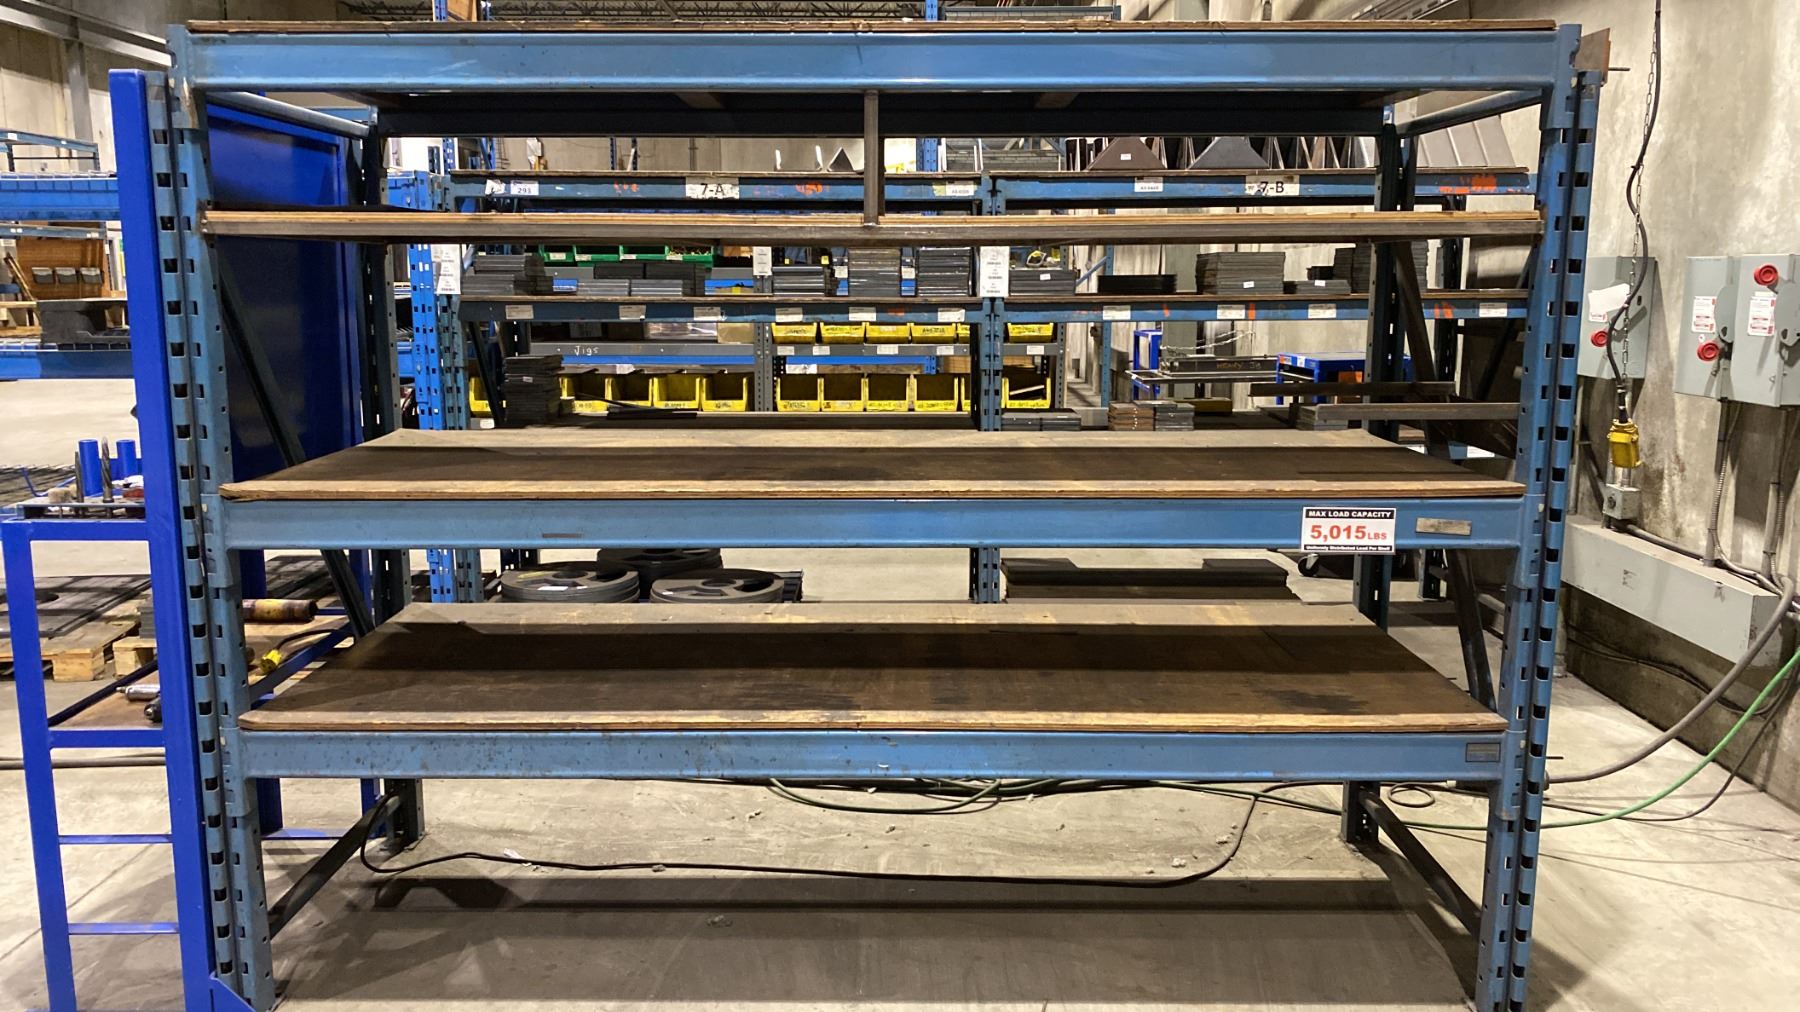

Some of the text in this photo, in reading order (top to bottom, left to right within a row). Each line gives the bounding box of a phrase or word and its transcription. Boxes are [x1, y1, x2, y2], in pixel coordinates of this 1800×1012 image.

[700, 182, 725, 196] 7-A
[1260, 181, 1285, 193] 7-B
[574, 345, 599, 356] Jigs
[1310, 524, 1387, 542] 5,015 LBS
